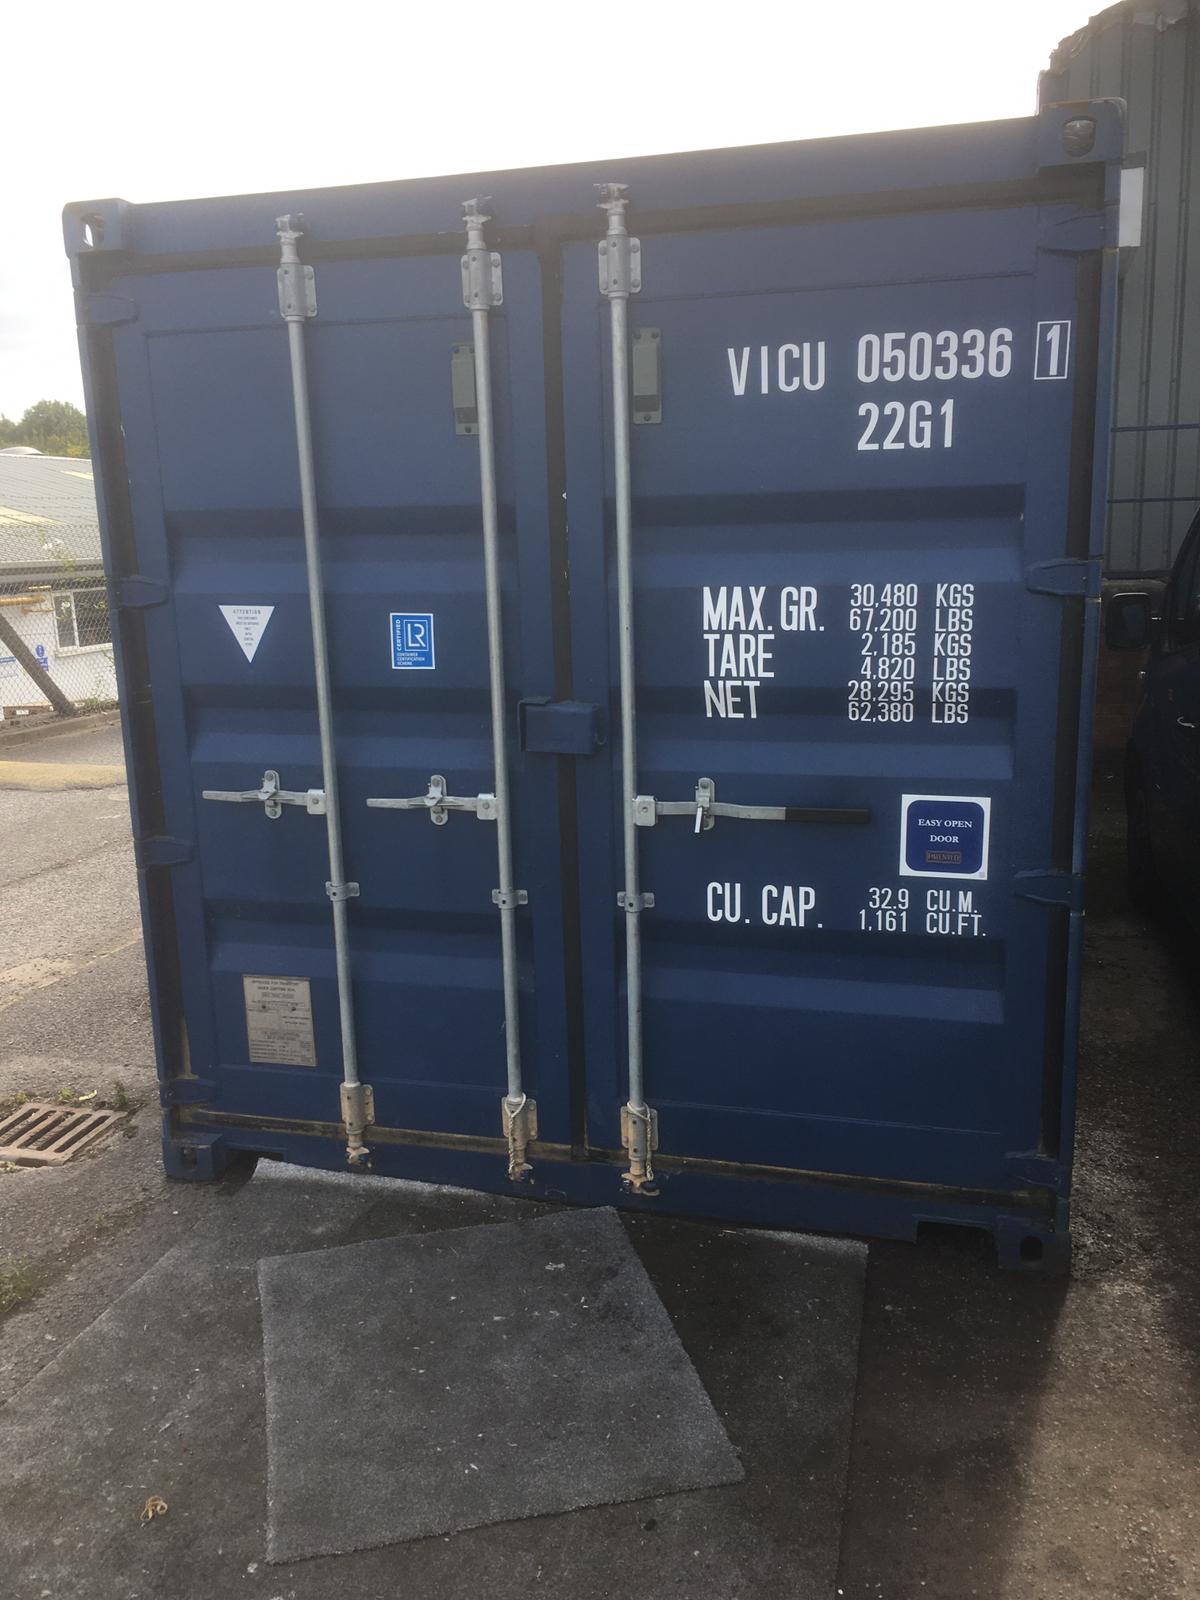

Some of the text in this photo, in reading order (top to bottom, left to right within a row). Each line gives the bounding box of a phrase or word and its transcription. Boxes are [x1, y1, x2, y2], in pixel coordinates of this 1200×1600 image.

[727, 324, 1060, 396] VICU 050336 1
[857, 399, 955, 451] 22G1
[702, 583, 975, 632] MAX. GR. 30,480 KGS
[849, 608, 974, 633] 67,200 LBS
[703, 632, 972, 678] TARE 2,185 KGS
[860, 657, 971, 681] 4,820 LBS
[703, 680, 970, 719] NET 28,295 KGS
[848, 702, 969, 724] 62,380 LBS
[918, 818, 973, 828] EASY OPEN
[929, 834, 960, 843] DOOR
[706, 881, 978, 928] CU. CAP. 32.9 CU.M.
[859, 908, 987, 937] 1,161 CU.FT.
